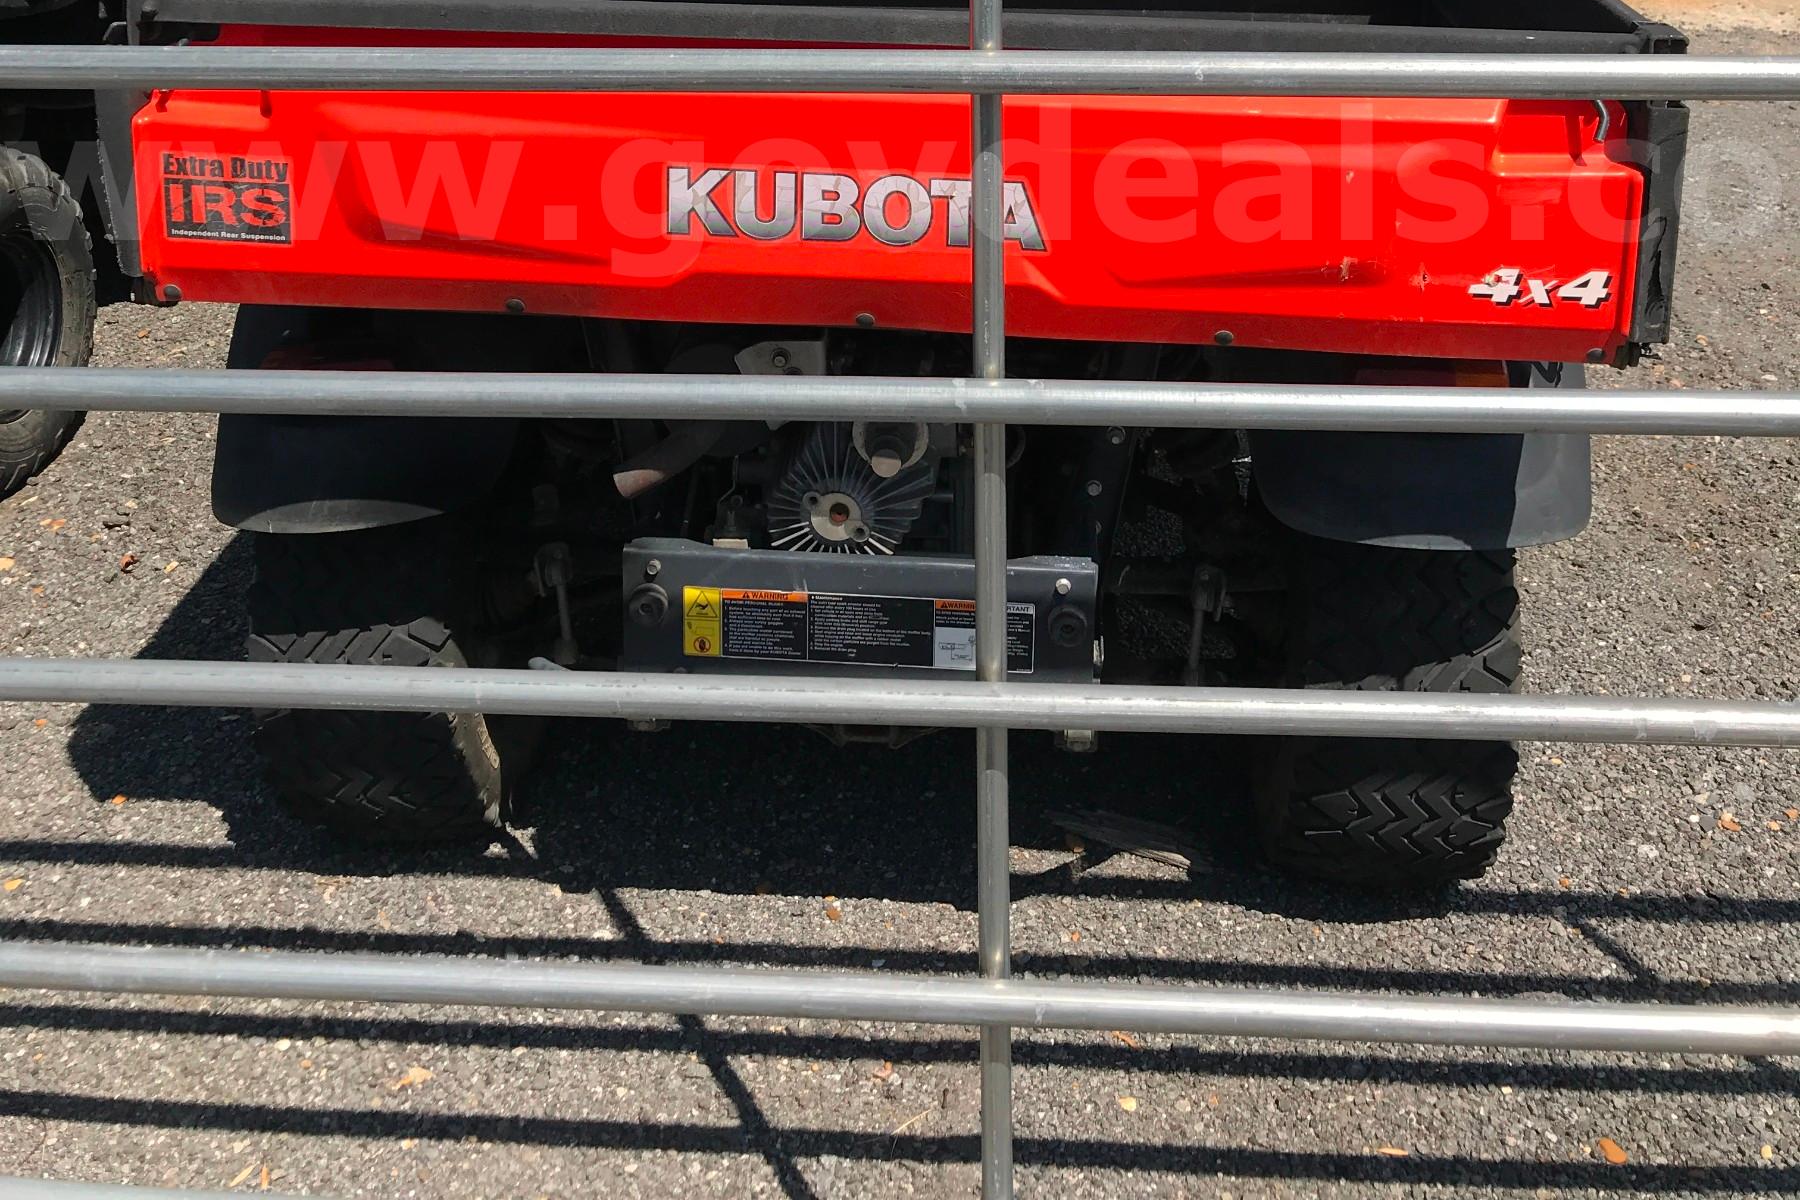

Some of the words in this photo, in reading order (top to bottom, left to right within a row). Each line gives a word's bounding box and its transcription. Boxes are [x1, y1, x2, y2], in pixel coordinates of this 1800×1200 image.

[163, 153, 224, 177] Extra
[230, 157, 289, 182] Duty
[169, 183, 286, 228] IRS
[666, 165, 1048, 252] KUBOTA
[171, 228, 220, 238] Independent
[220, 231, 239, 239] Rear
[240, 232, 286, 241] Suspension
[1467, 267, 1613, 309] 4x4
[752, 592, 789, 601] WARNING
